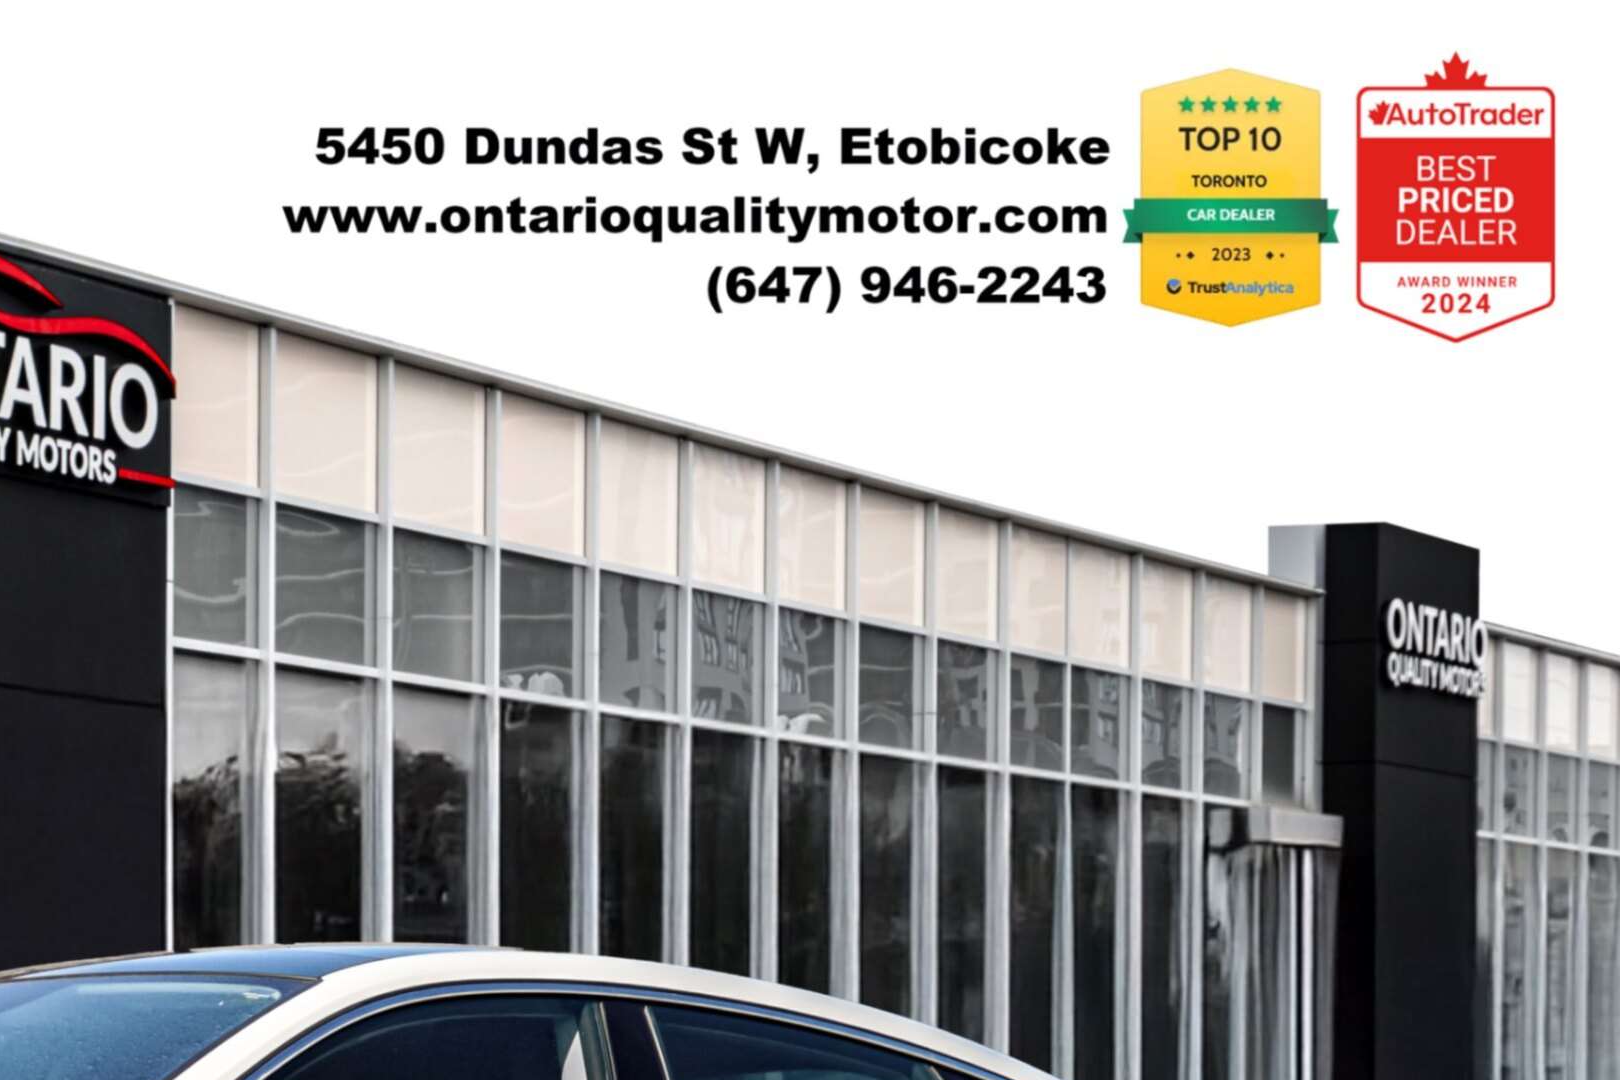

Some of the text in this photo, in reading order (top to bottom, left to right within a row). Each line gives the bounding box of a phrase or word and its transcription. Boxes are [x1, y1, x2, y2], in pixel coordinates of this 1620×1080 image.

[16, 429, 118, 485] MOTORS
[1386, 597, 1488, 668] ONTARIO
[1386, 650, 1440, 689] QUALITY
